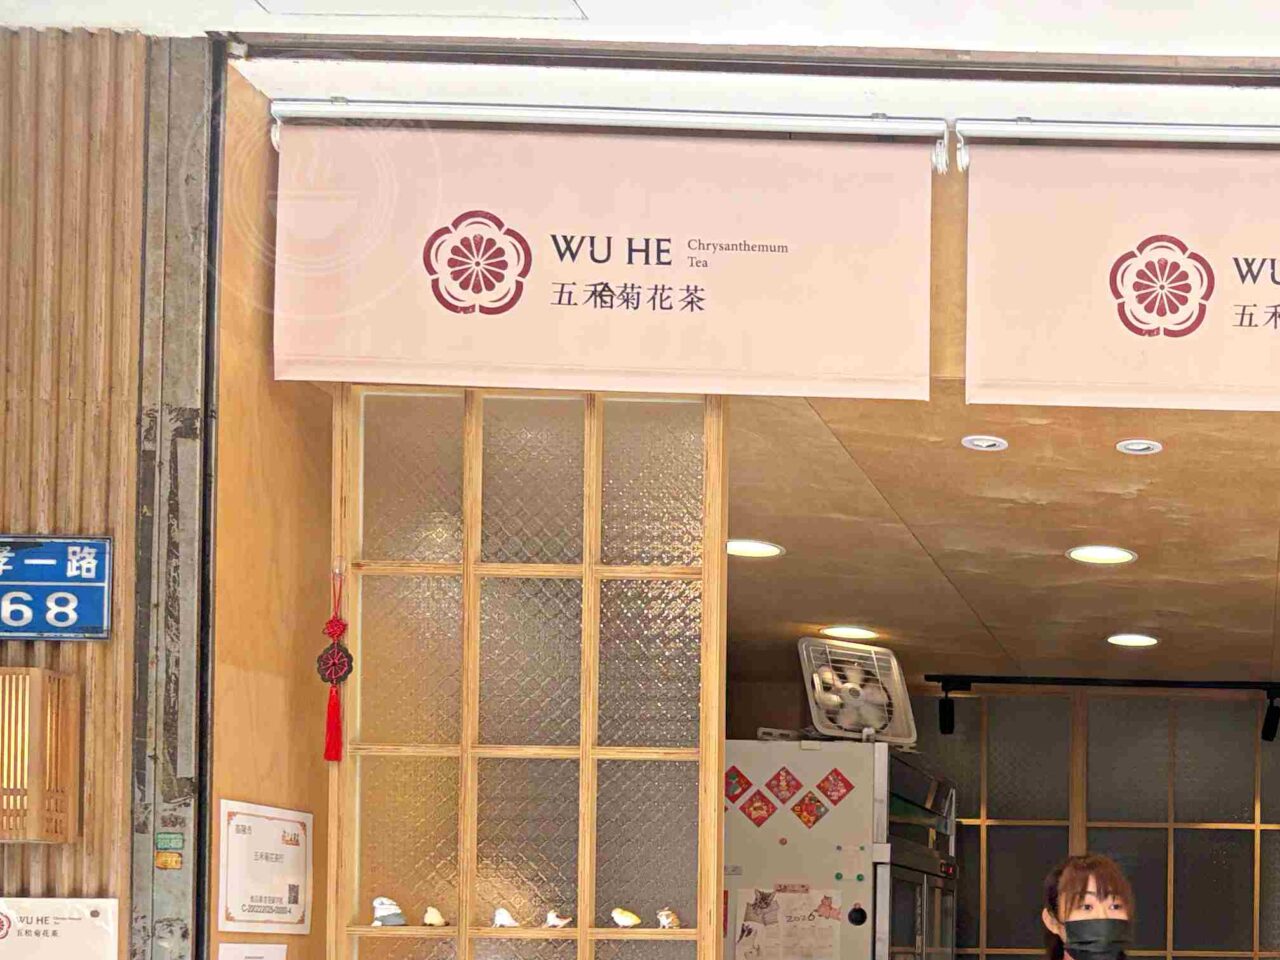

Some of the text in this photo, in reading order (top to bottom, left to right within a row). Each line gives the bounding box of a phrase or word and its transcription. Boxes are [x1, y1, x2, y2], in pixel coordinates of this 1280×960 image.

[550, 234, 789, 265] WU HE Chrysanthemum
[687, 256, 709, 268] Tea
[1, 591, 78, 627] 68
